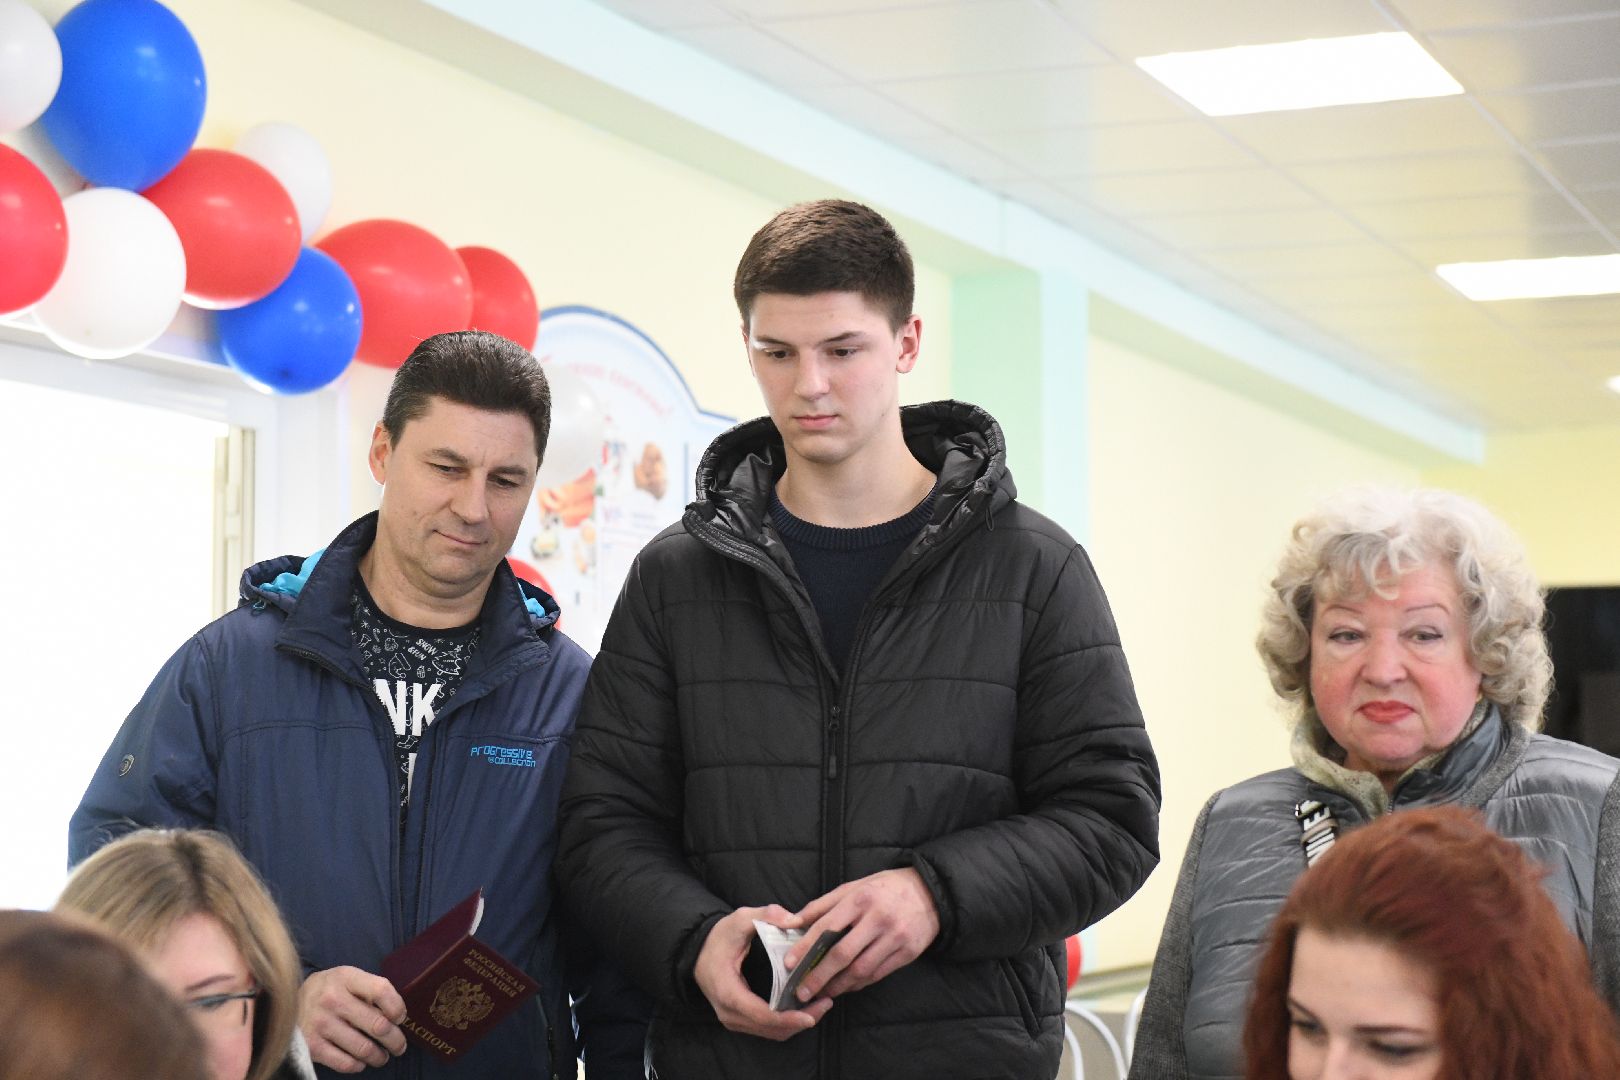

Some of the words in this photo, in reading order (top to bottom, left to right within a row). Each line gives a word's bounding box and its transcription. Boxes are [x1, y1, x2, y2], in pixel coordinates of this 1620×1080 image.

[415, 638, 438, 656] SNOW
[463, 957, 518, 998] ФЕДЕРАЦИЯ
[468, 949, 526, 993] РОССИЙСКАЯ
